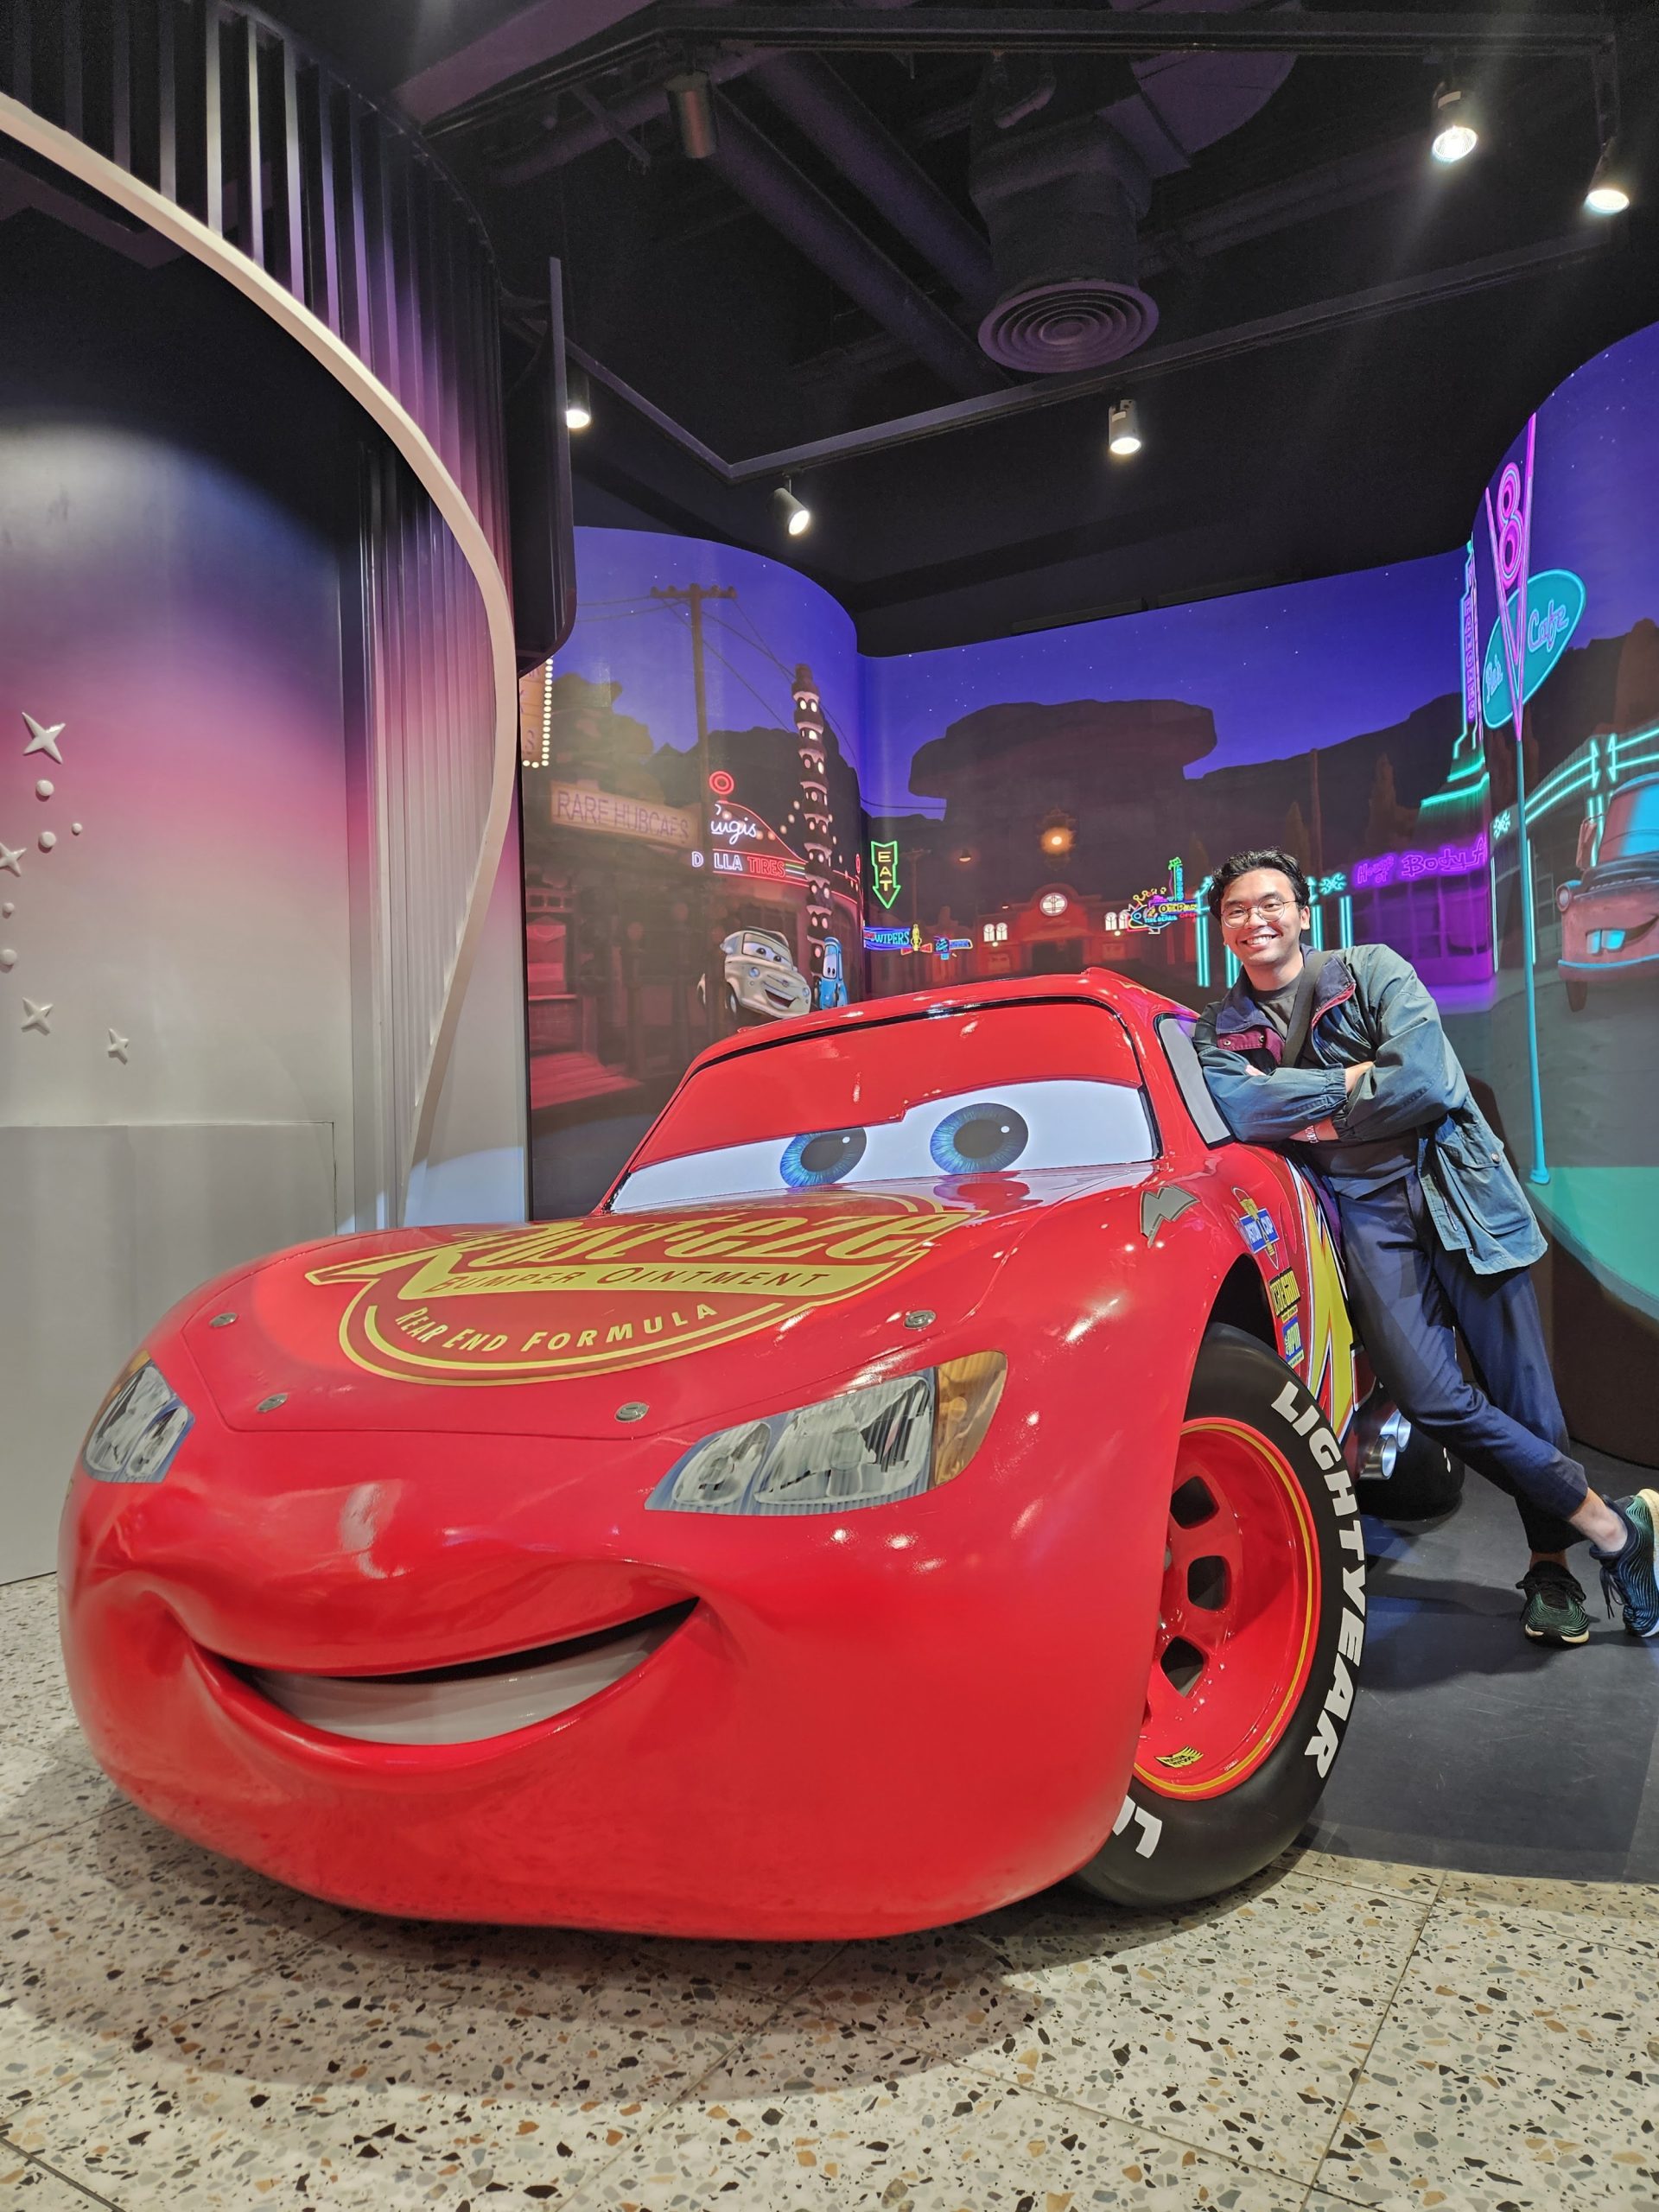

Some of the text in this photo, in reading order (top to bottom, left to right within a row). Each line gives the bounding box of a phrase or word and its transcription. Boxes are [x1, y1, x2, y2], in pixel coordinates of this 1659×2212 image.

[556, 790, 609, 824] RARE
[747, 856, 786, 878] TIRES
[878, 851, 893, 892] EAT
[874, 931, 910, 945] WIPERS
[421, 1266, 830, 1294] BUMPER OINTMENT
[394, 1303, 718, 1353] REAR END FORMULA
[1271, 1381, 1366, 1779] LIGHTYEAR
